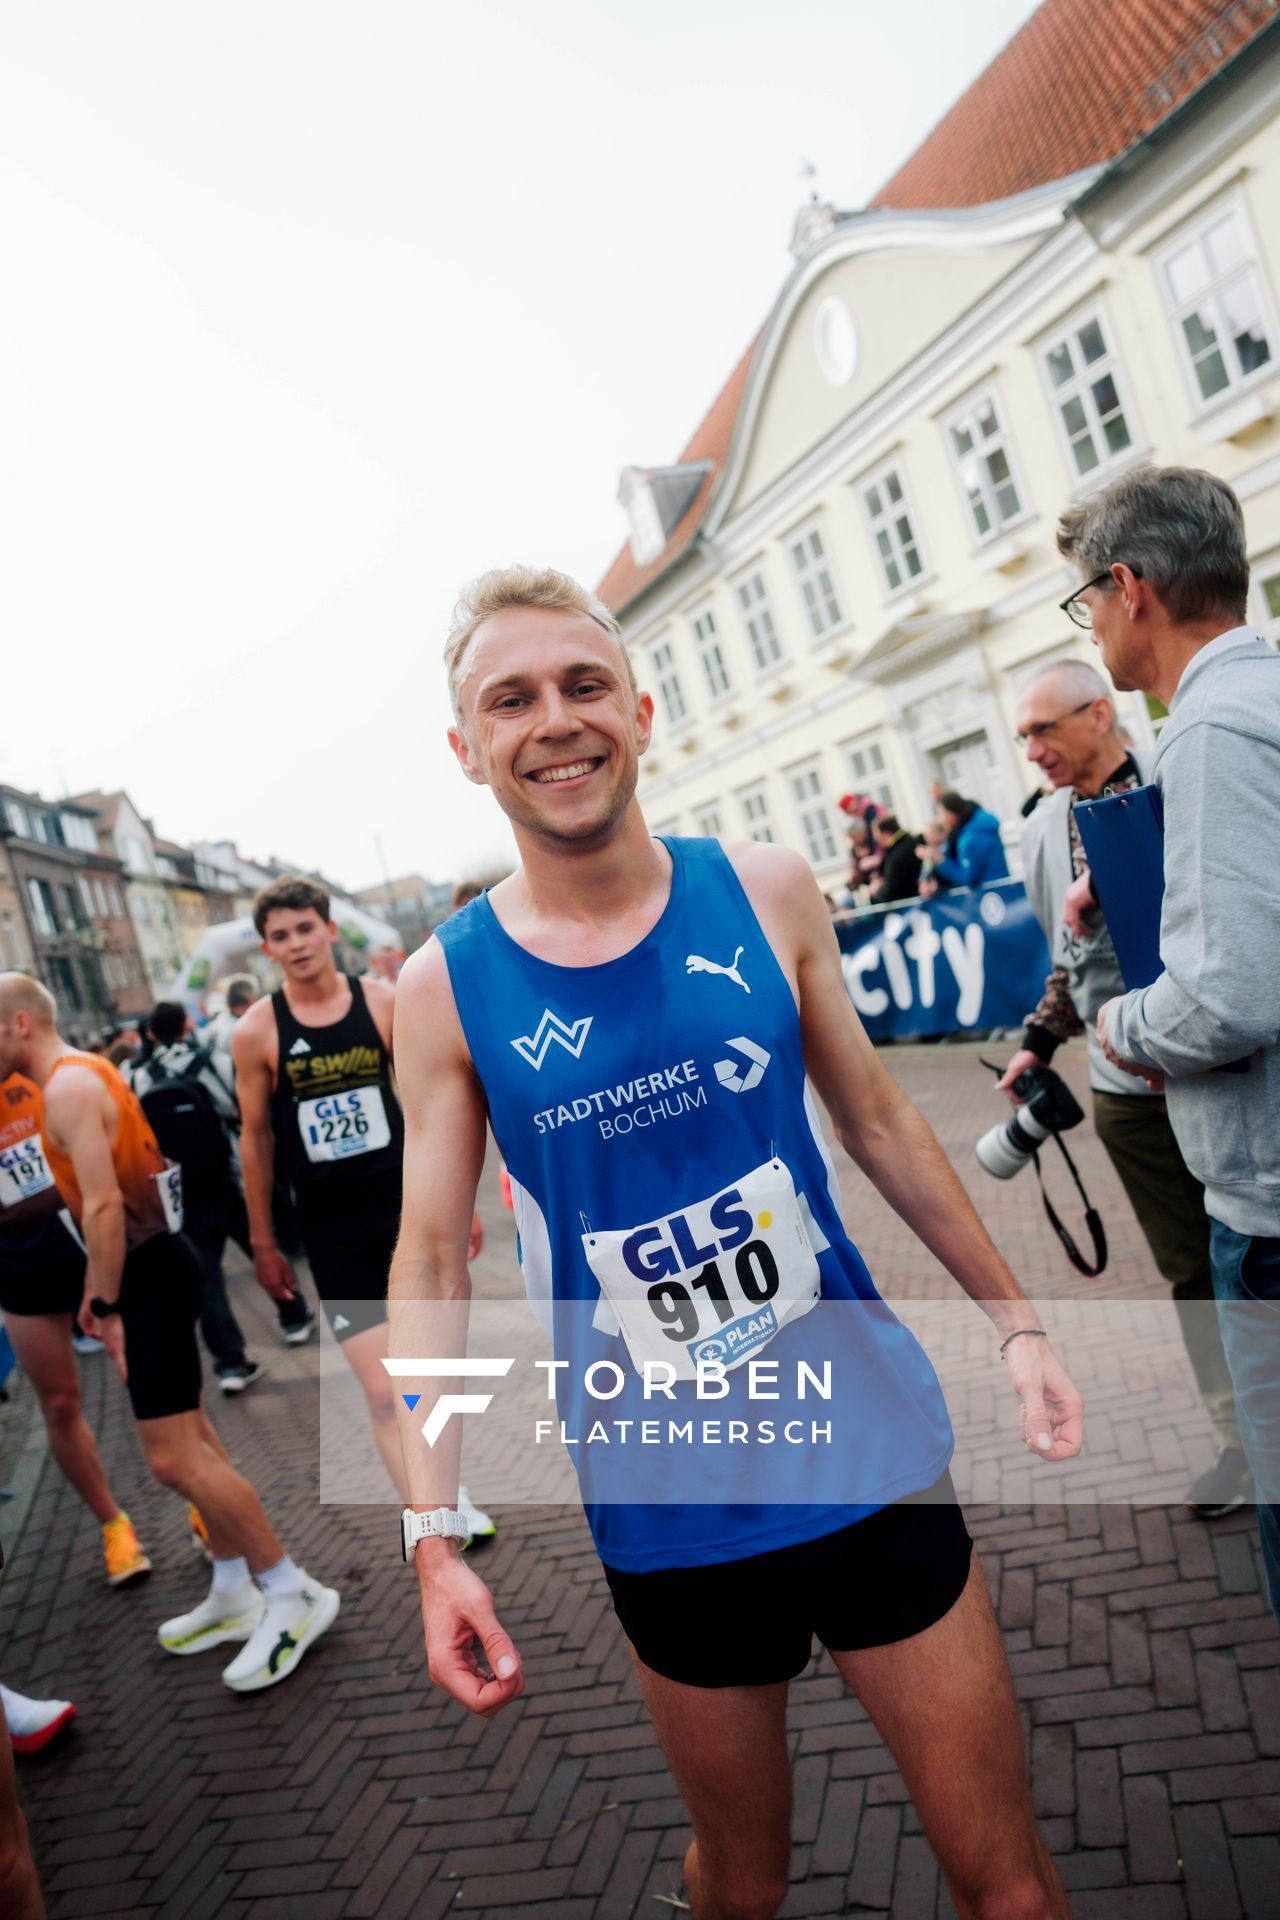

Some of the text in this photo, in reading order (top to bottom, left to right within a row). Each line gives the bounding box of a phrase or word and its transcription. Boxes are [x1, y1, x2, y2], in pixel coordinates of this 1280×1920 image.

[533, 1059, 700, 1134] STADTWERKE
[598, 1086, 708, 1140] BOCHUM
[321, 1113, 369, 1143] 226
[8, 1156, 44, 1185] 197
[647, 1239, 780, 1343] 910
[725, 1311, 774, 1348] PLAN
[732, 1327, 775, 1355] INTERNATIONAL
